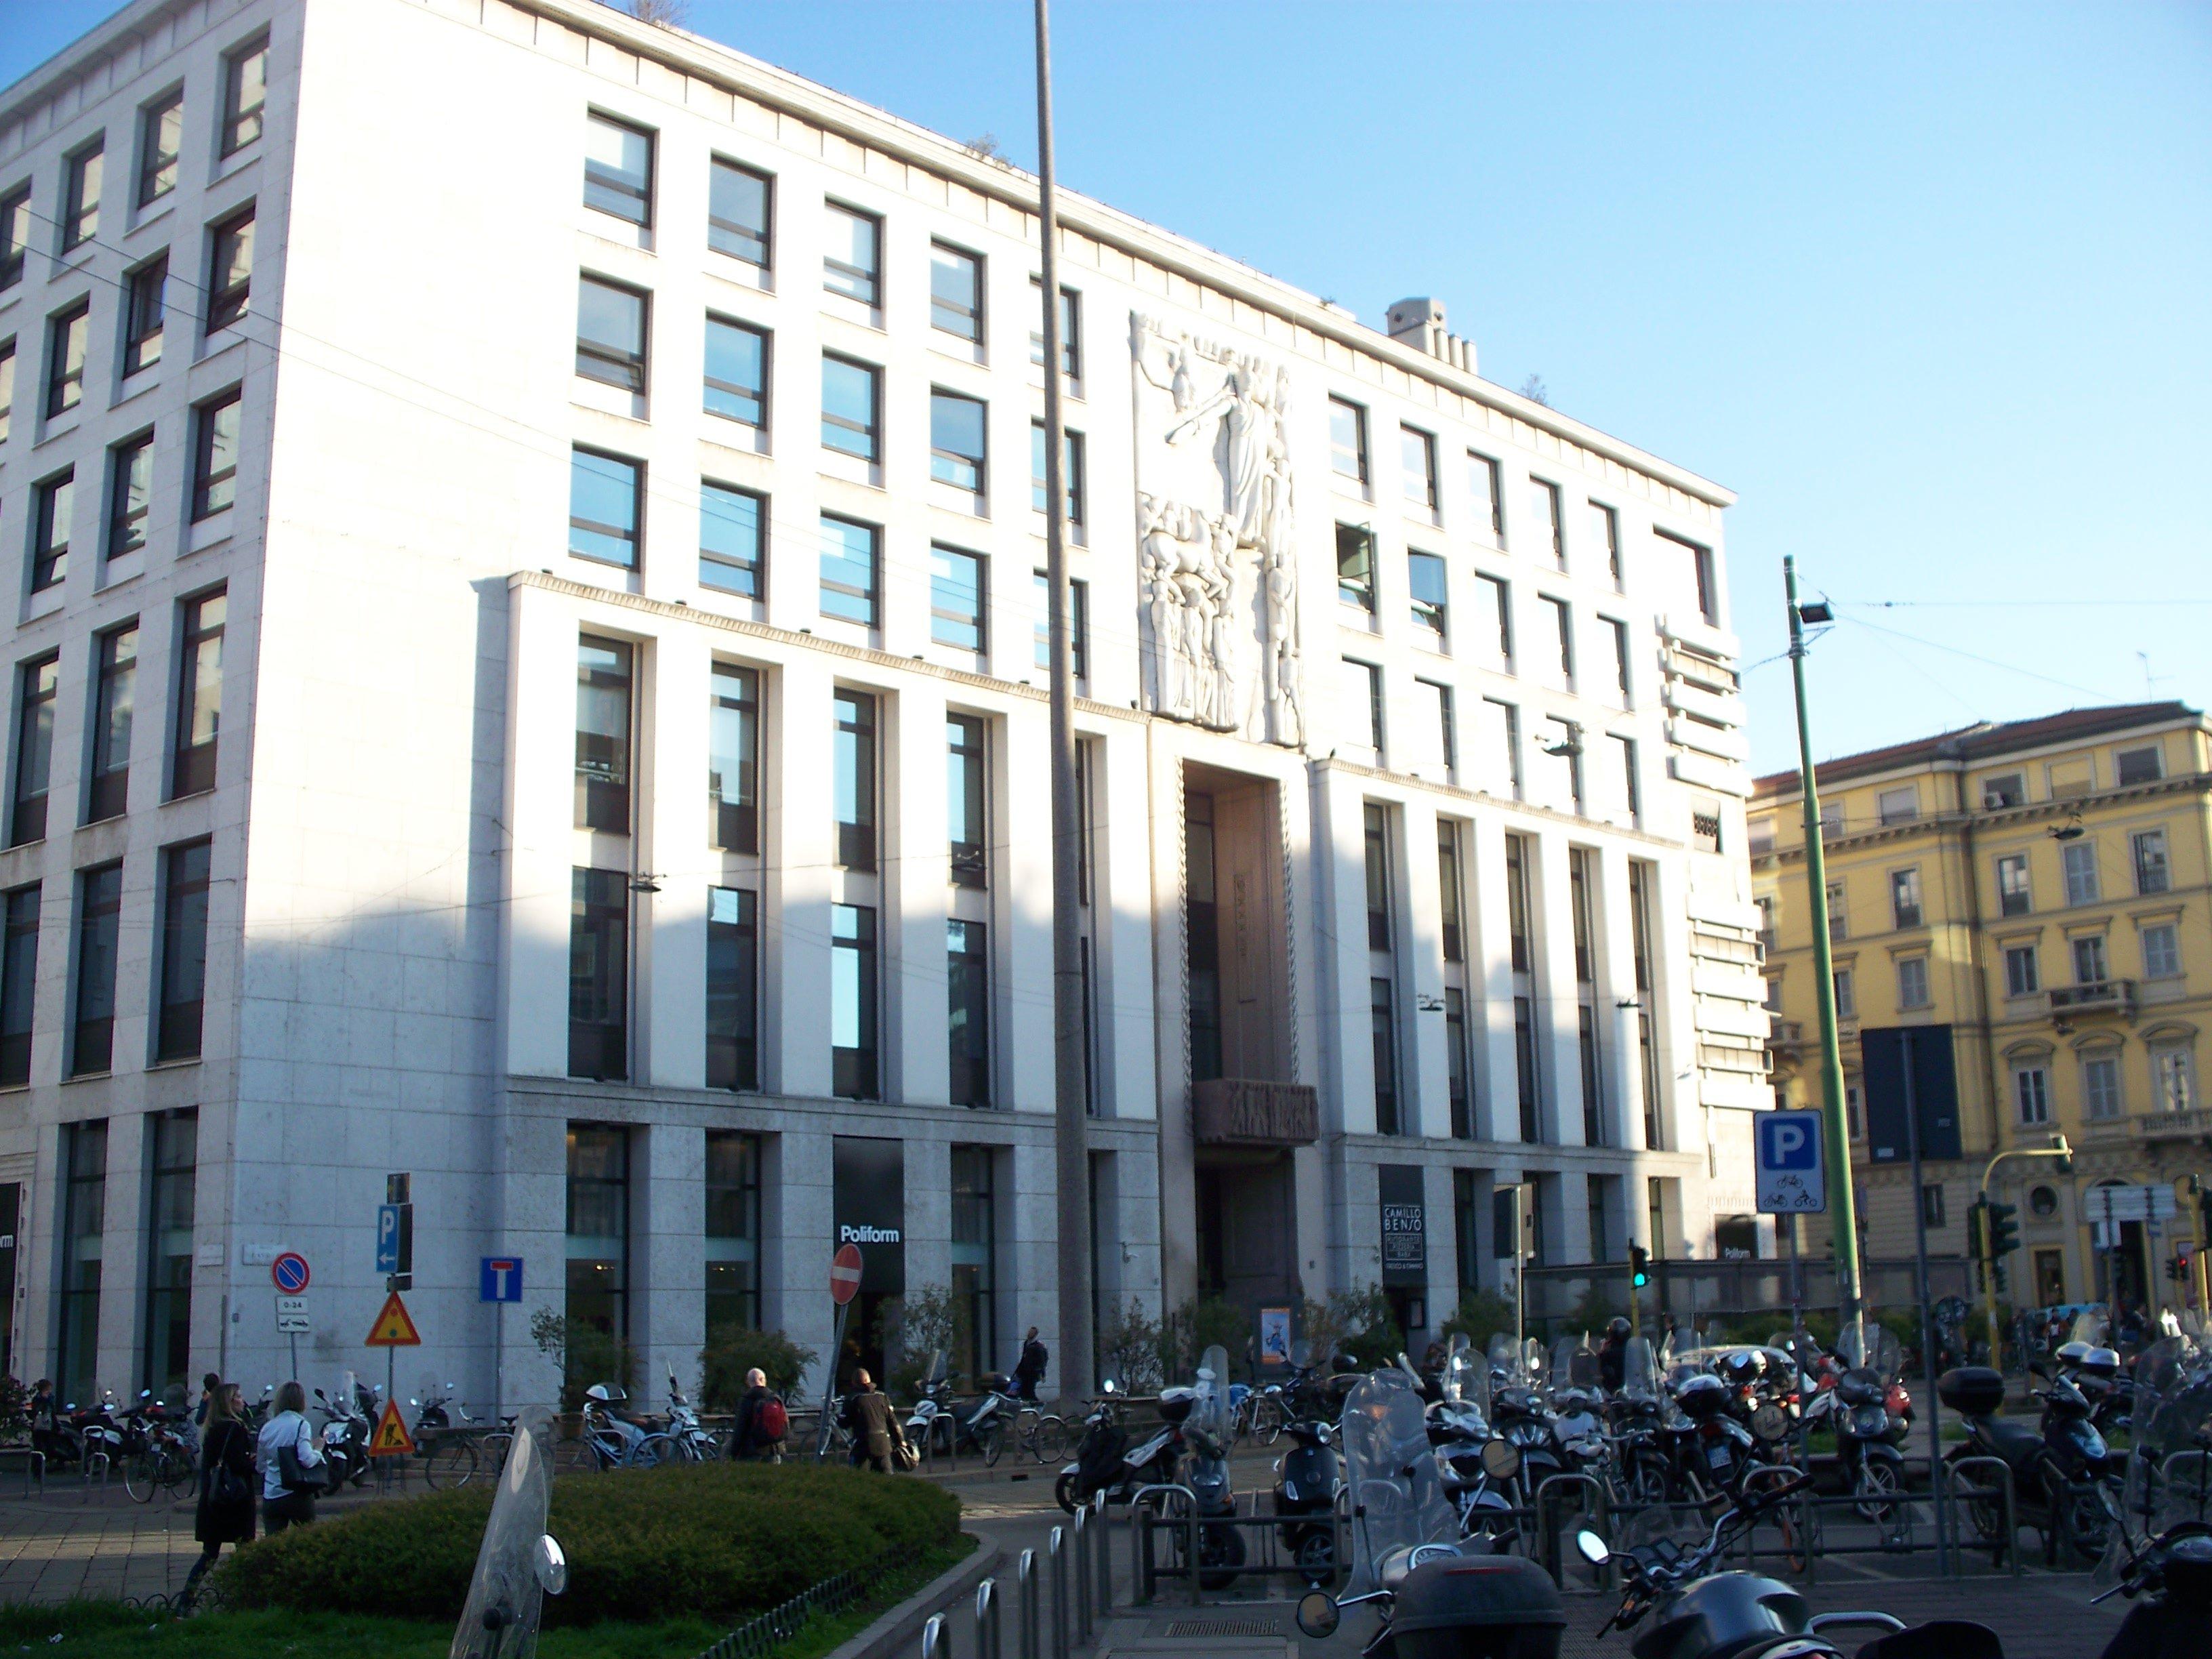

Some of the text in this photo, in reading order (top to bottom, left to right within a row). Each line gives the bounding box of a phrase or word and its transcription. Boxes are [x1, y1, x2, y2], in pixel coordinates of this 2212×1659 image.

[1774, 1124, 1805, 1164] P
[1385, 1208, 1421, 1218] CAMILLO
[1385, 1219, 1422, 1231] BENSO
[841, 1225, 899, 1242] Poliform
